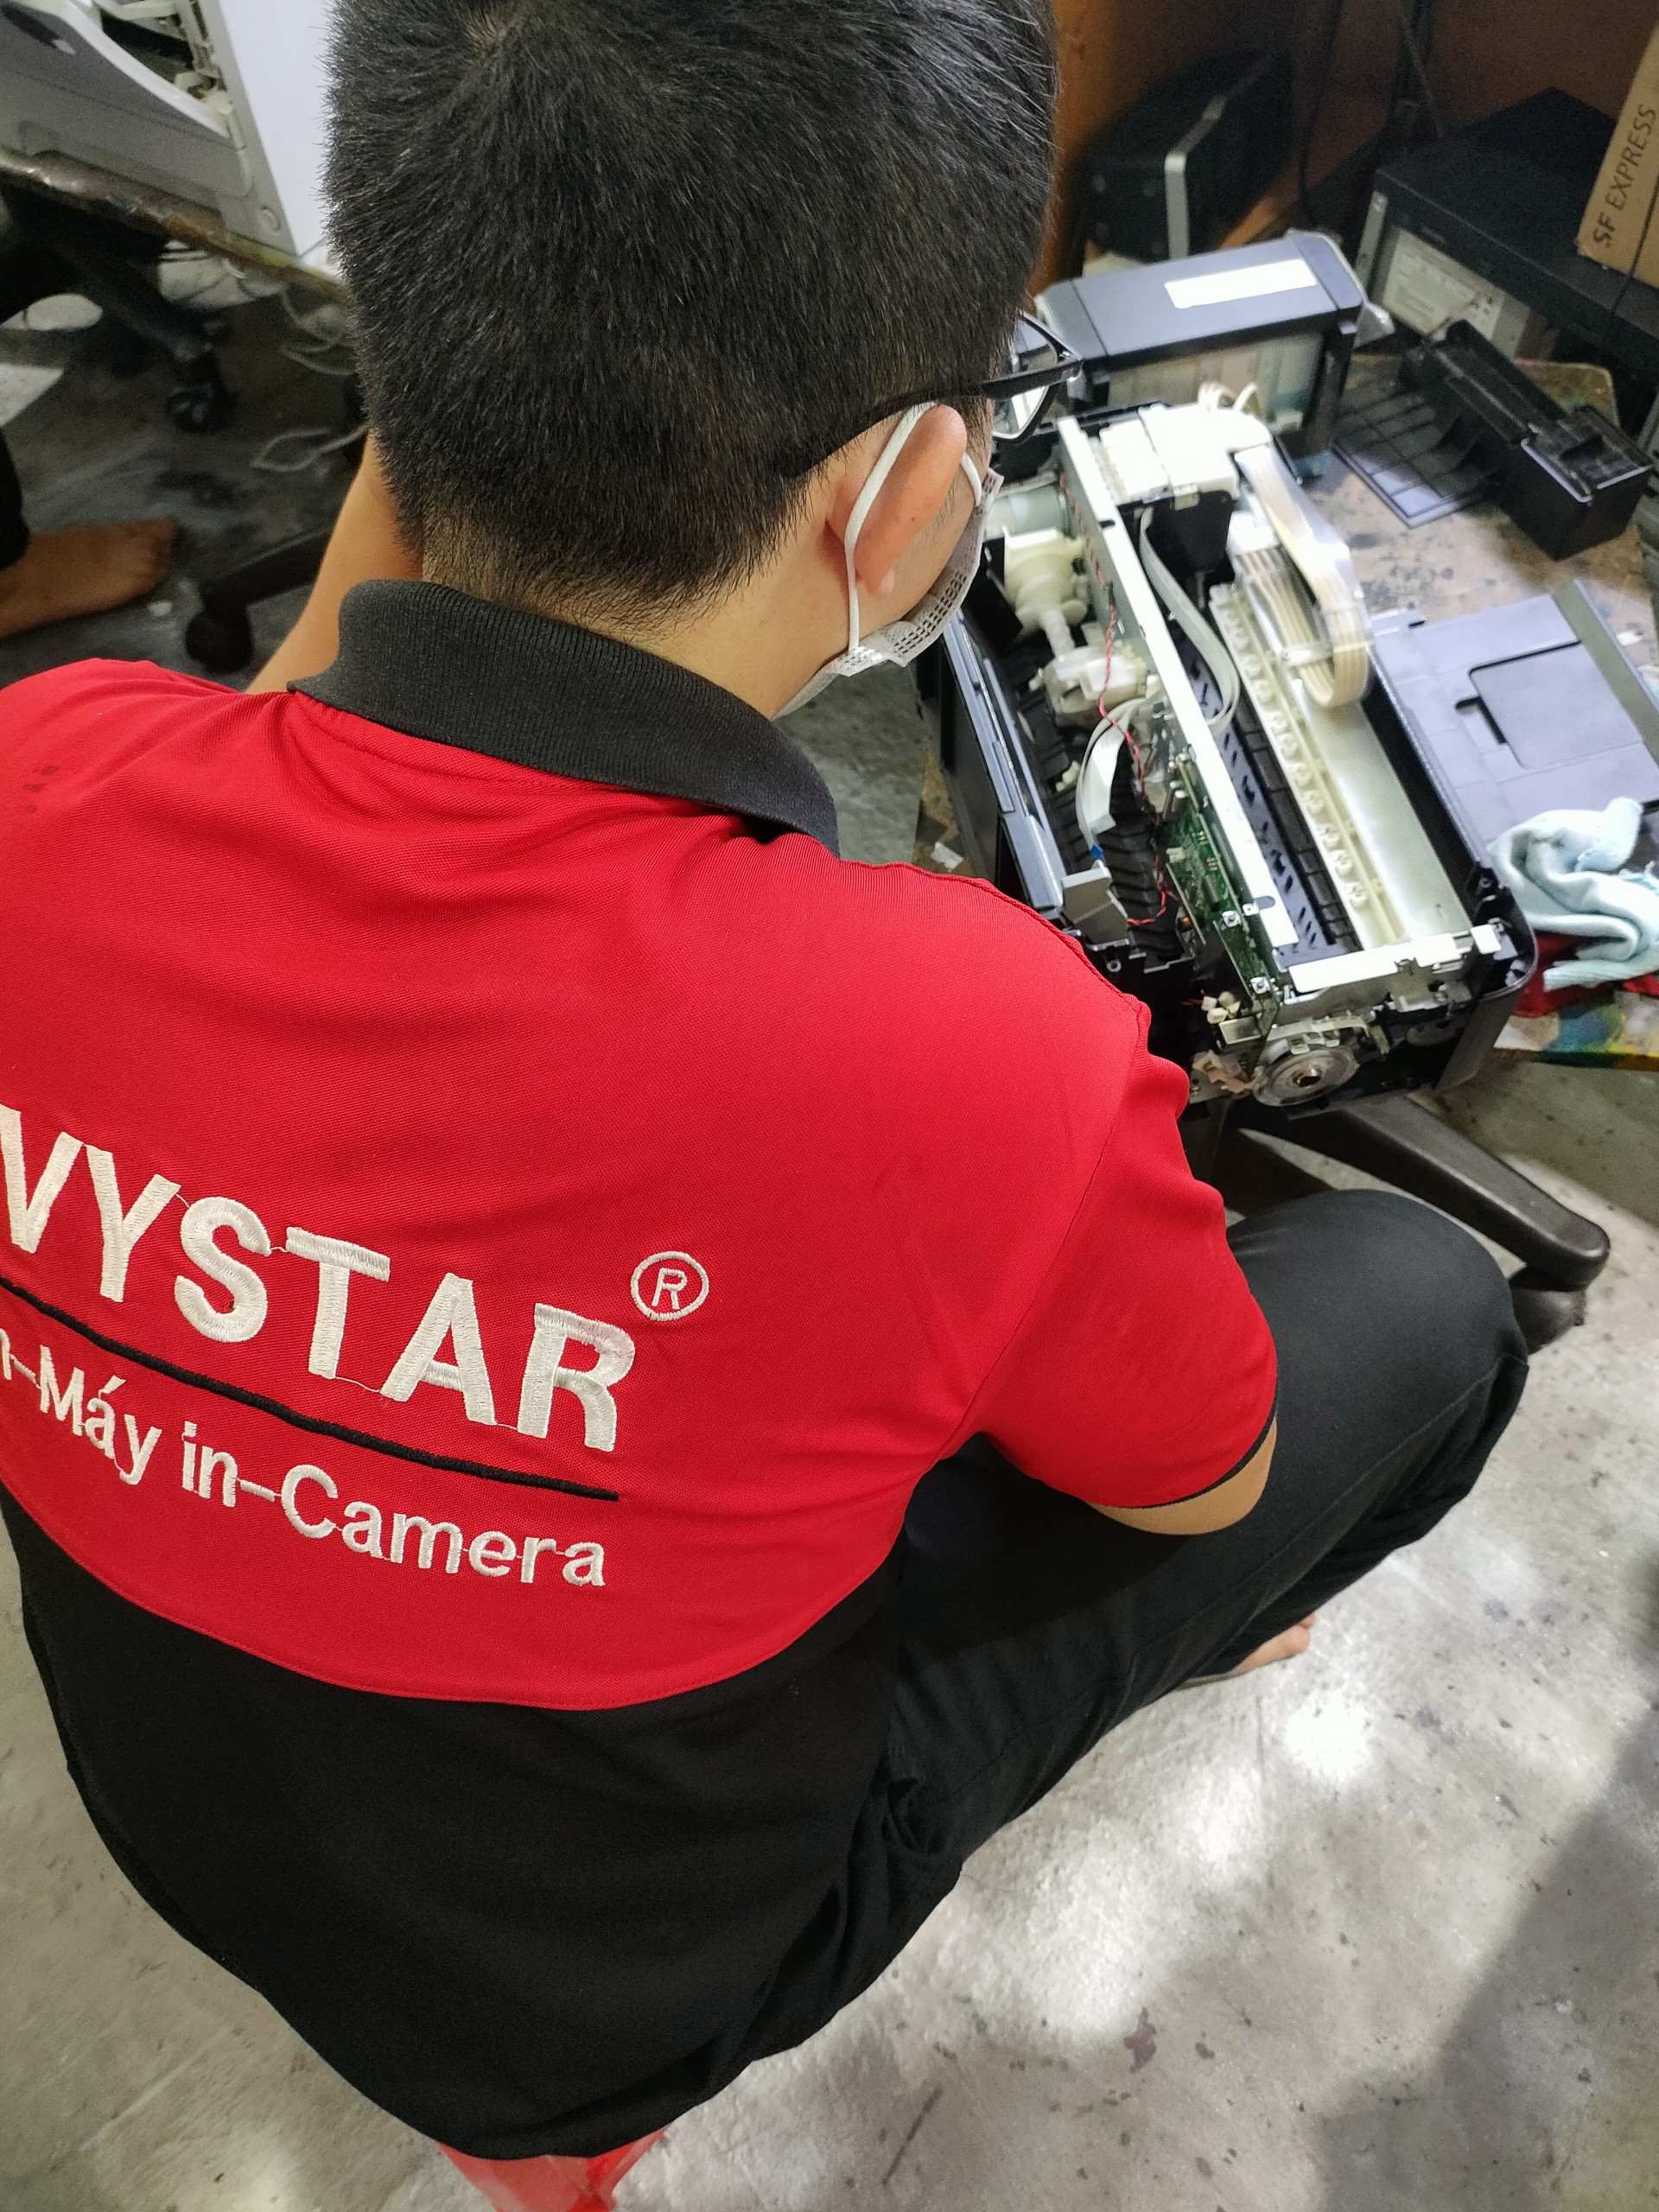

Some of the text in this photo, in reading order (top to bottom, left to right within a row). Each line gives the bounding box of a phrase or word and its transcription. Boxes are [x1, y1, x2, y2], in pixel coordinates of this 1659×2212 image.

[1592, 104, 1656, 248] SF EXPRESS
[0, 1103, 635, 1452] VYSTAR
